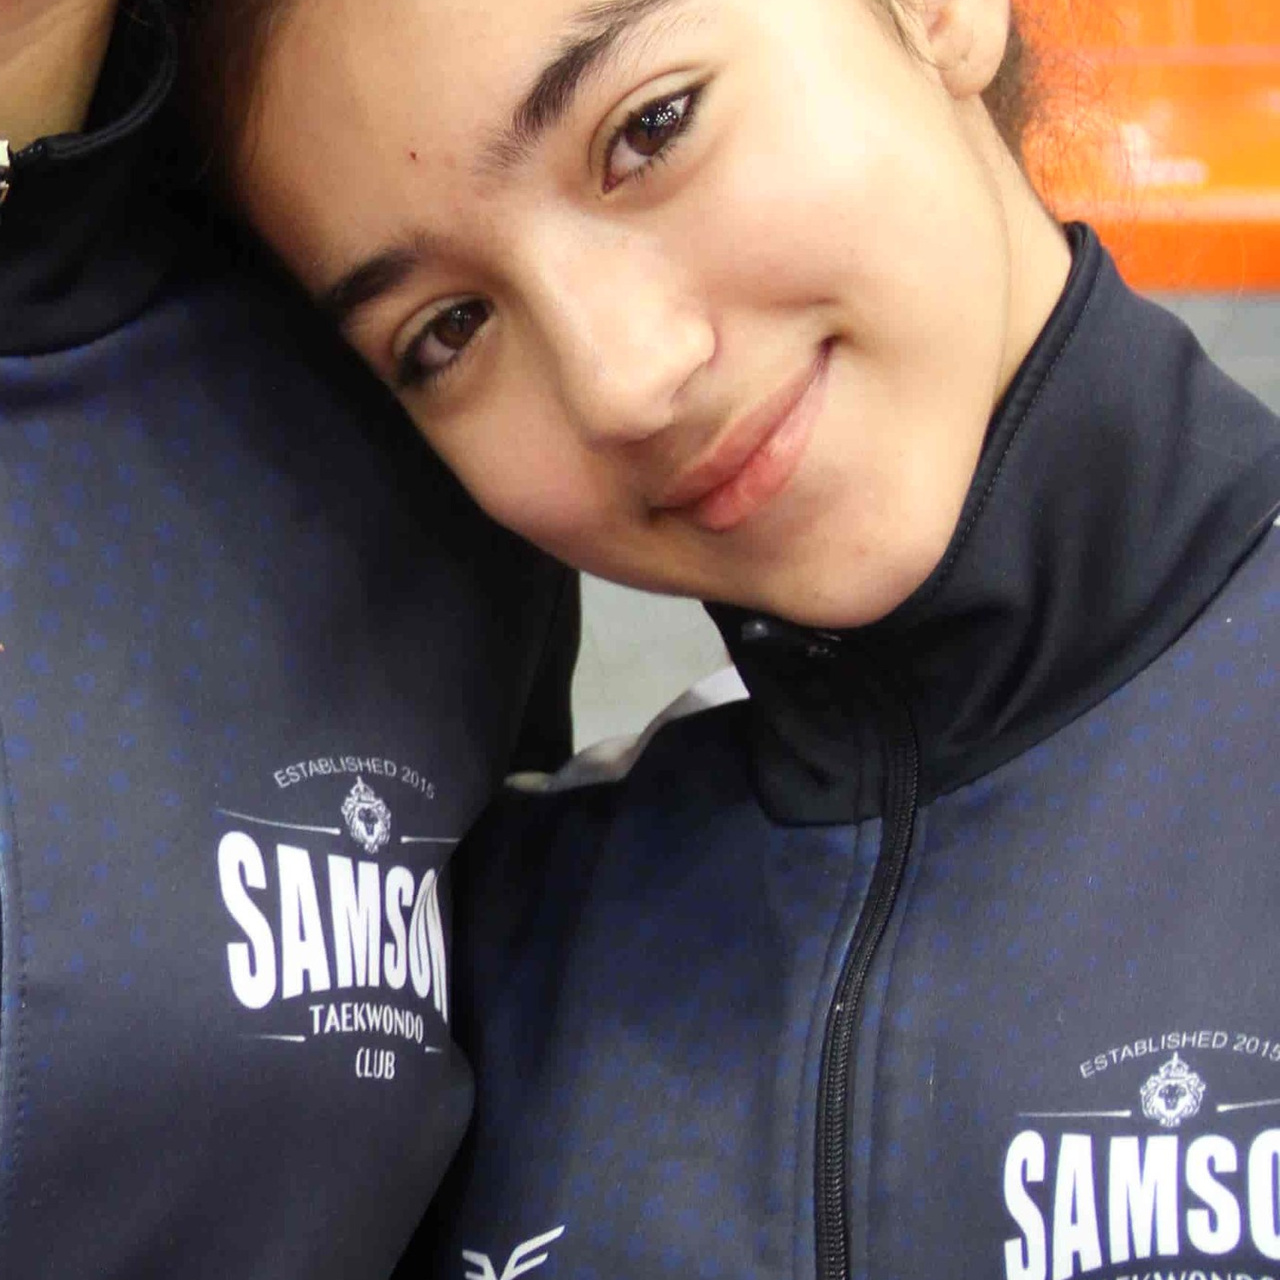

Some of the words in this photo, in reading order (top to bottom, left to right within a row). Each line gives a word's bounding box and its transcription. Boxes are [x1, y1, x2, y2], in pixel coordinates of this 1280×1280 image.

[273, 756, 397, 789] ESTABLISHED
[401, 767, 436, 800] 2015
[309, 1002, 424, 1044] TAEKWONDO
[355, 1047, 396, 1080] CLUB
[1079, 1030, 1228, 1079] ESTABLISHED
